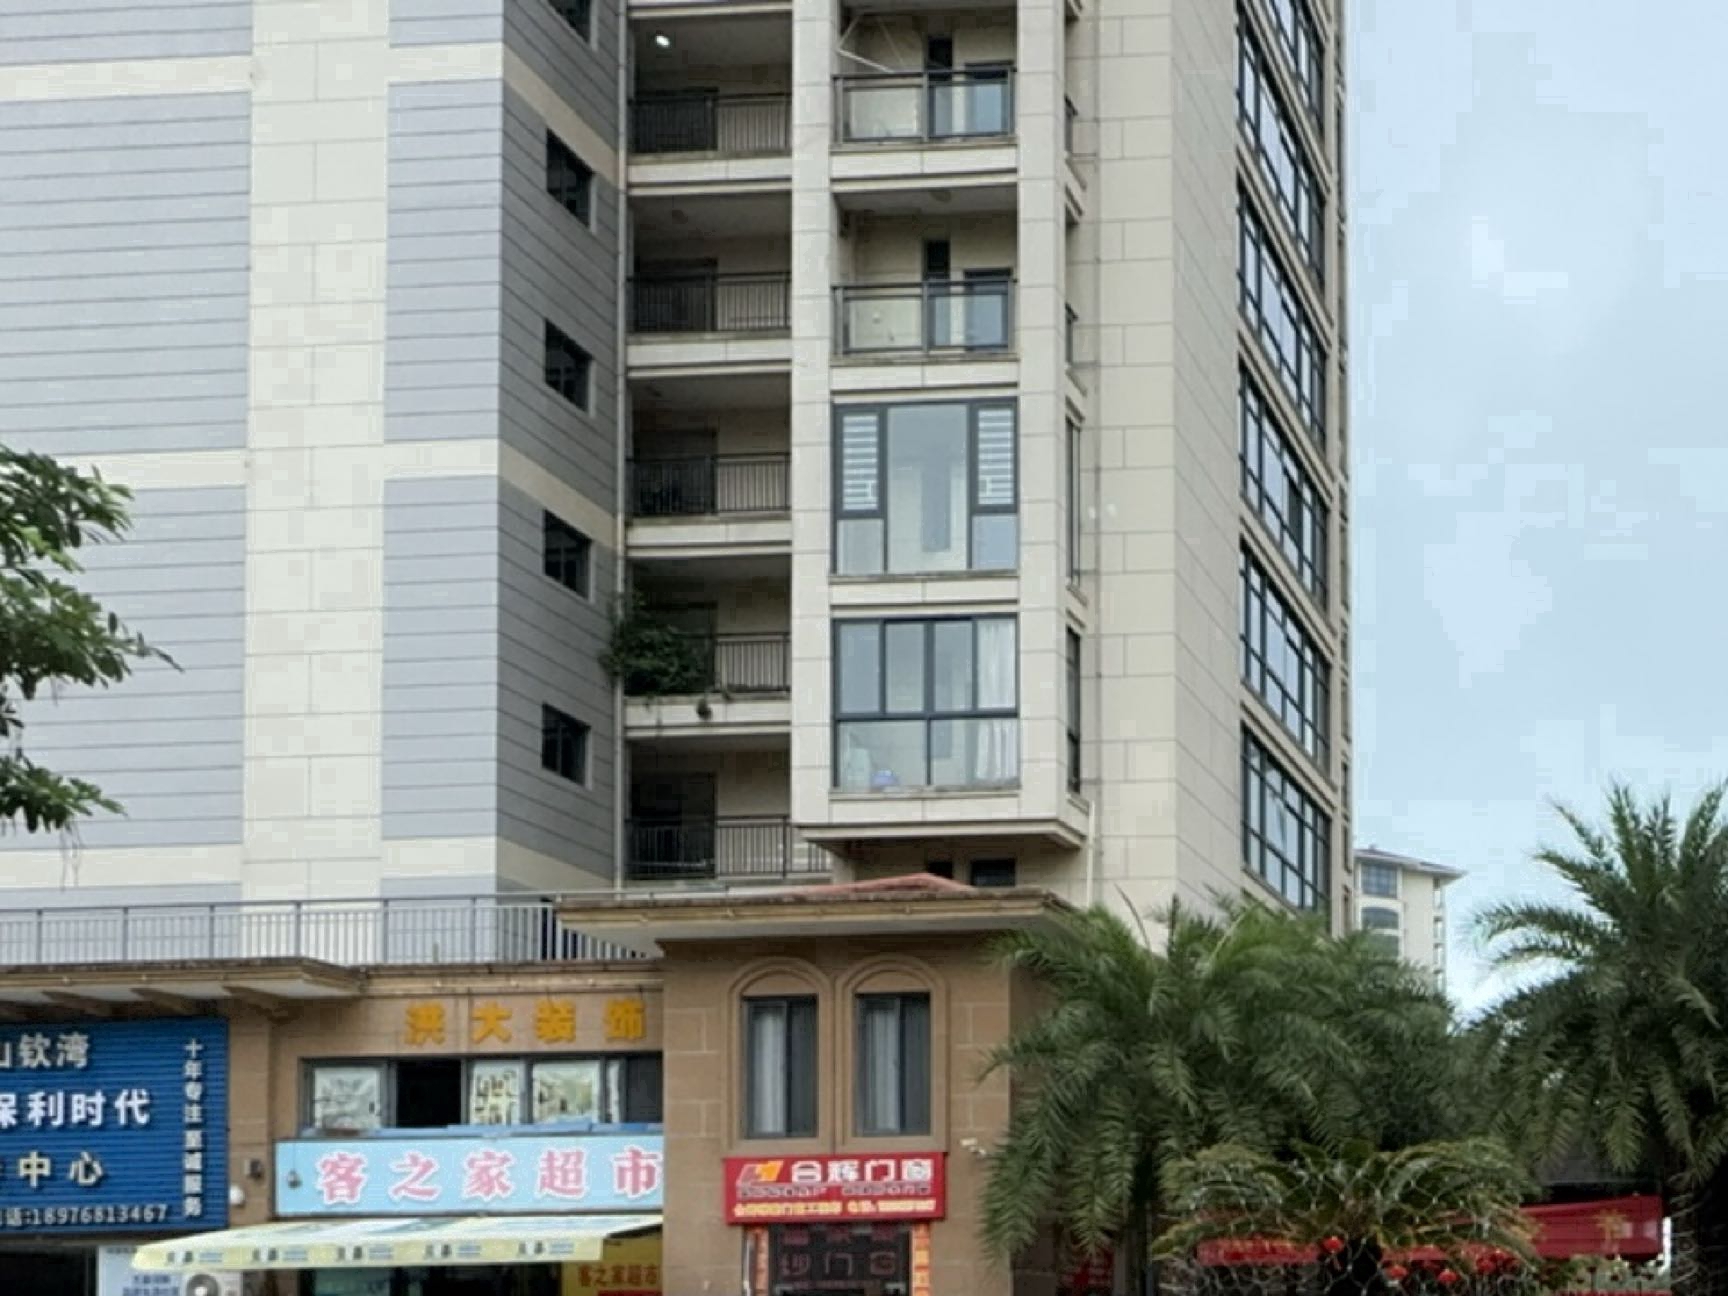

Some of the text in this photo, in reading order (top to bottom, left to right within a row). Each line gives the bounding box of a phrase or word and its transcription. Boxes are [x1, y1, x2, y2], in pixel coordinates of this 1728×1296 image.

[0, 1151, 103, 1188] 中心
[319, 1148, 662, 1205] 客之家超市
